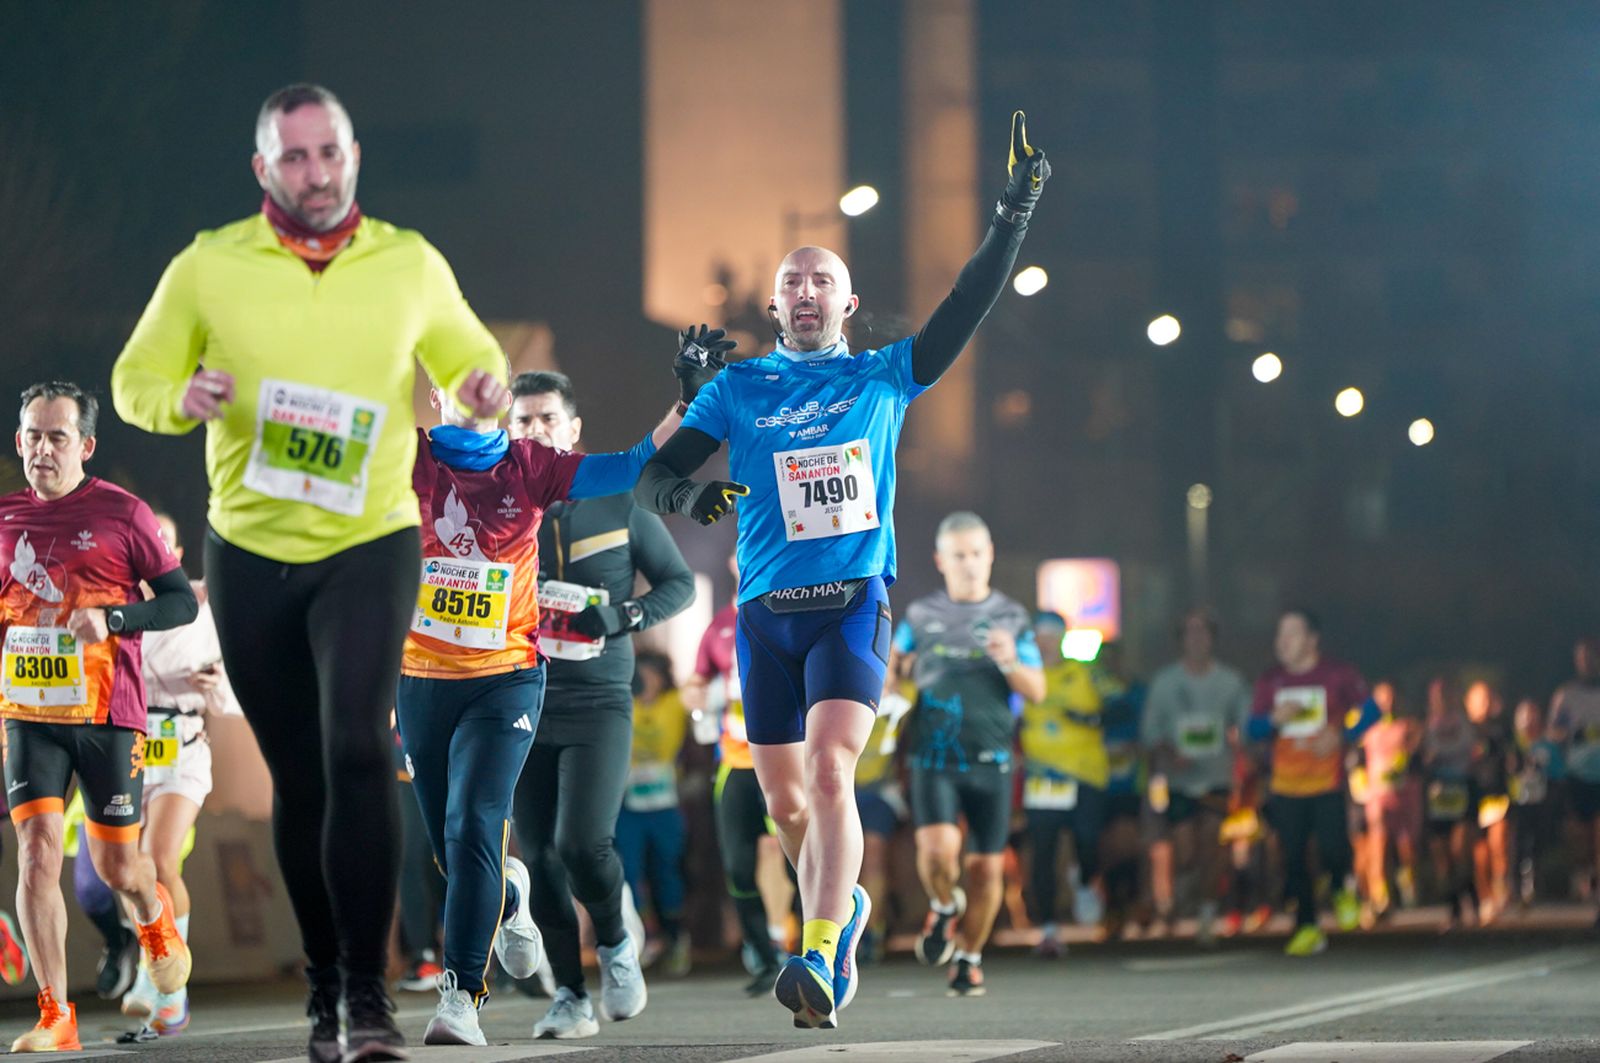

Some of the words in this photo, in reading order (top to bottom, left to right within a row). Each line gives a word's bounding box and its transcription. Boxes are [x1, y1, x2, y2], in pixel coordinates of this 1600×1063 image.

[779, 401, 819, 417] CLUB
[796, 424, 829, 438] AMBAR
[287, 426, 344, 470] 576
[798, 457, 825, 469] NOCHE
[827, 454, 838, 464] DE
[788, 470, 807, 482] SAN
[808, 463, 841, 479] ANTÓN
[799, 474, 858, 508] 7490
[824, 505, 843, 515] JESUS
[449, 533, 474, 556] 43
[26, 570, 46, 591] 43
[440, 566, 466, 578] NOCHE
[467, 570, 480, 580] DE
[428, 575, 445, 586] SAN
[446, 577, 479, 591] ANTÓN
[812, 580, 848, 598] MAX
[431, 588, 491, 619] 8515
[15, 655, 68, 679] 8300
